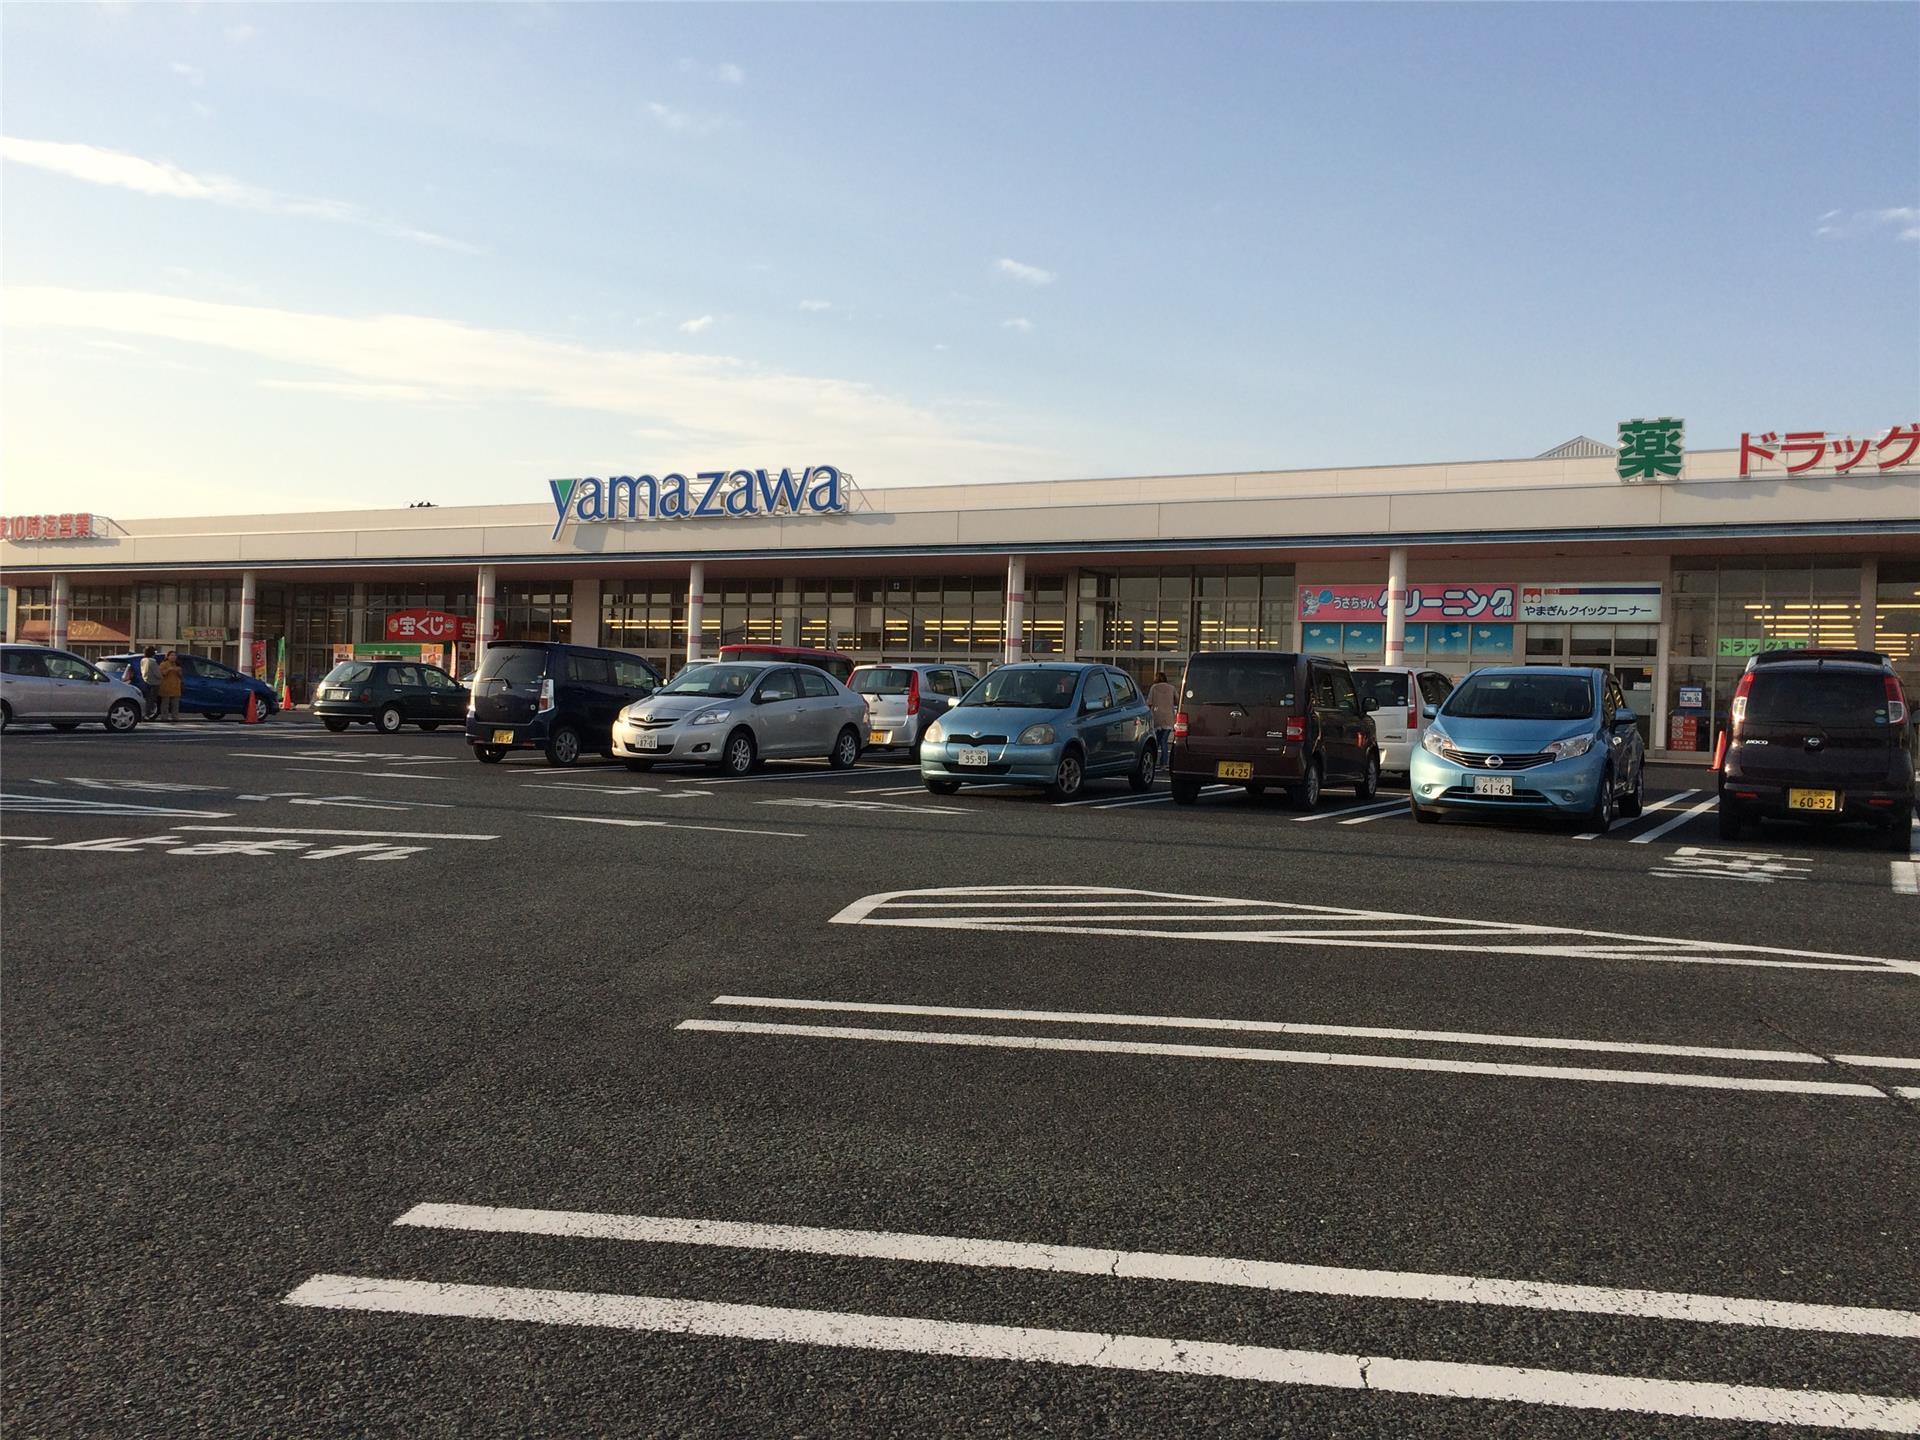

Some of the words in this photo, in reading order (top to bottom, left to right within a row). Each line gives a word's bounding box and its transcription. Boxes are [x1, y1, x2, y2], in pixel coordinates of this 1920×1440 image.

[1616, 418, 1685, 480] 薬
[1739, 423, 1920, 476] ドラッグ
[549, 465, 845, 541] yamazawa
[1333, 596, 1376, 609] うさちゃん
[1524, 605, 1652, 617] やまぎんクイックコーナー
[399, 616, 444, 636] 宝くじ
[964, 755, 987, 765] 95-90
[1225, 767, 1249, 778] 44-25
[1482, 783, 1511, 795] 61-63
[1799, 797, 1833, 809] 60-92
[18, 835, 434, 862] 止まれ
